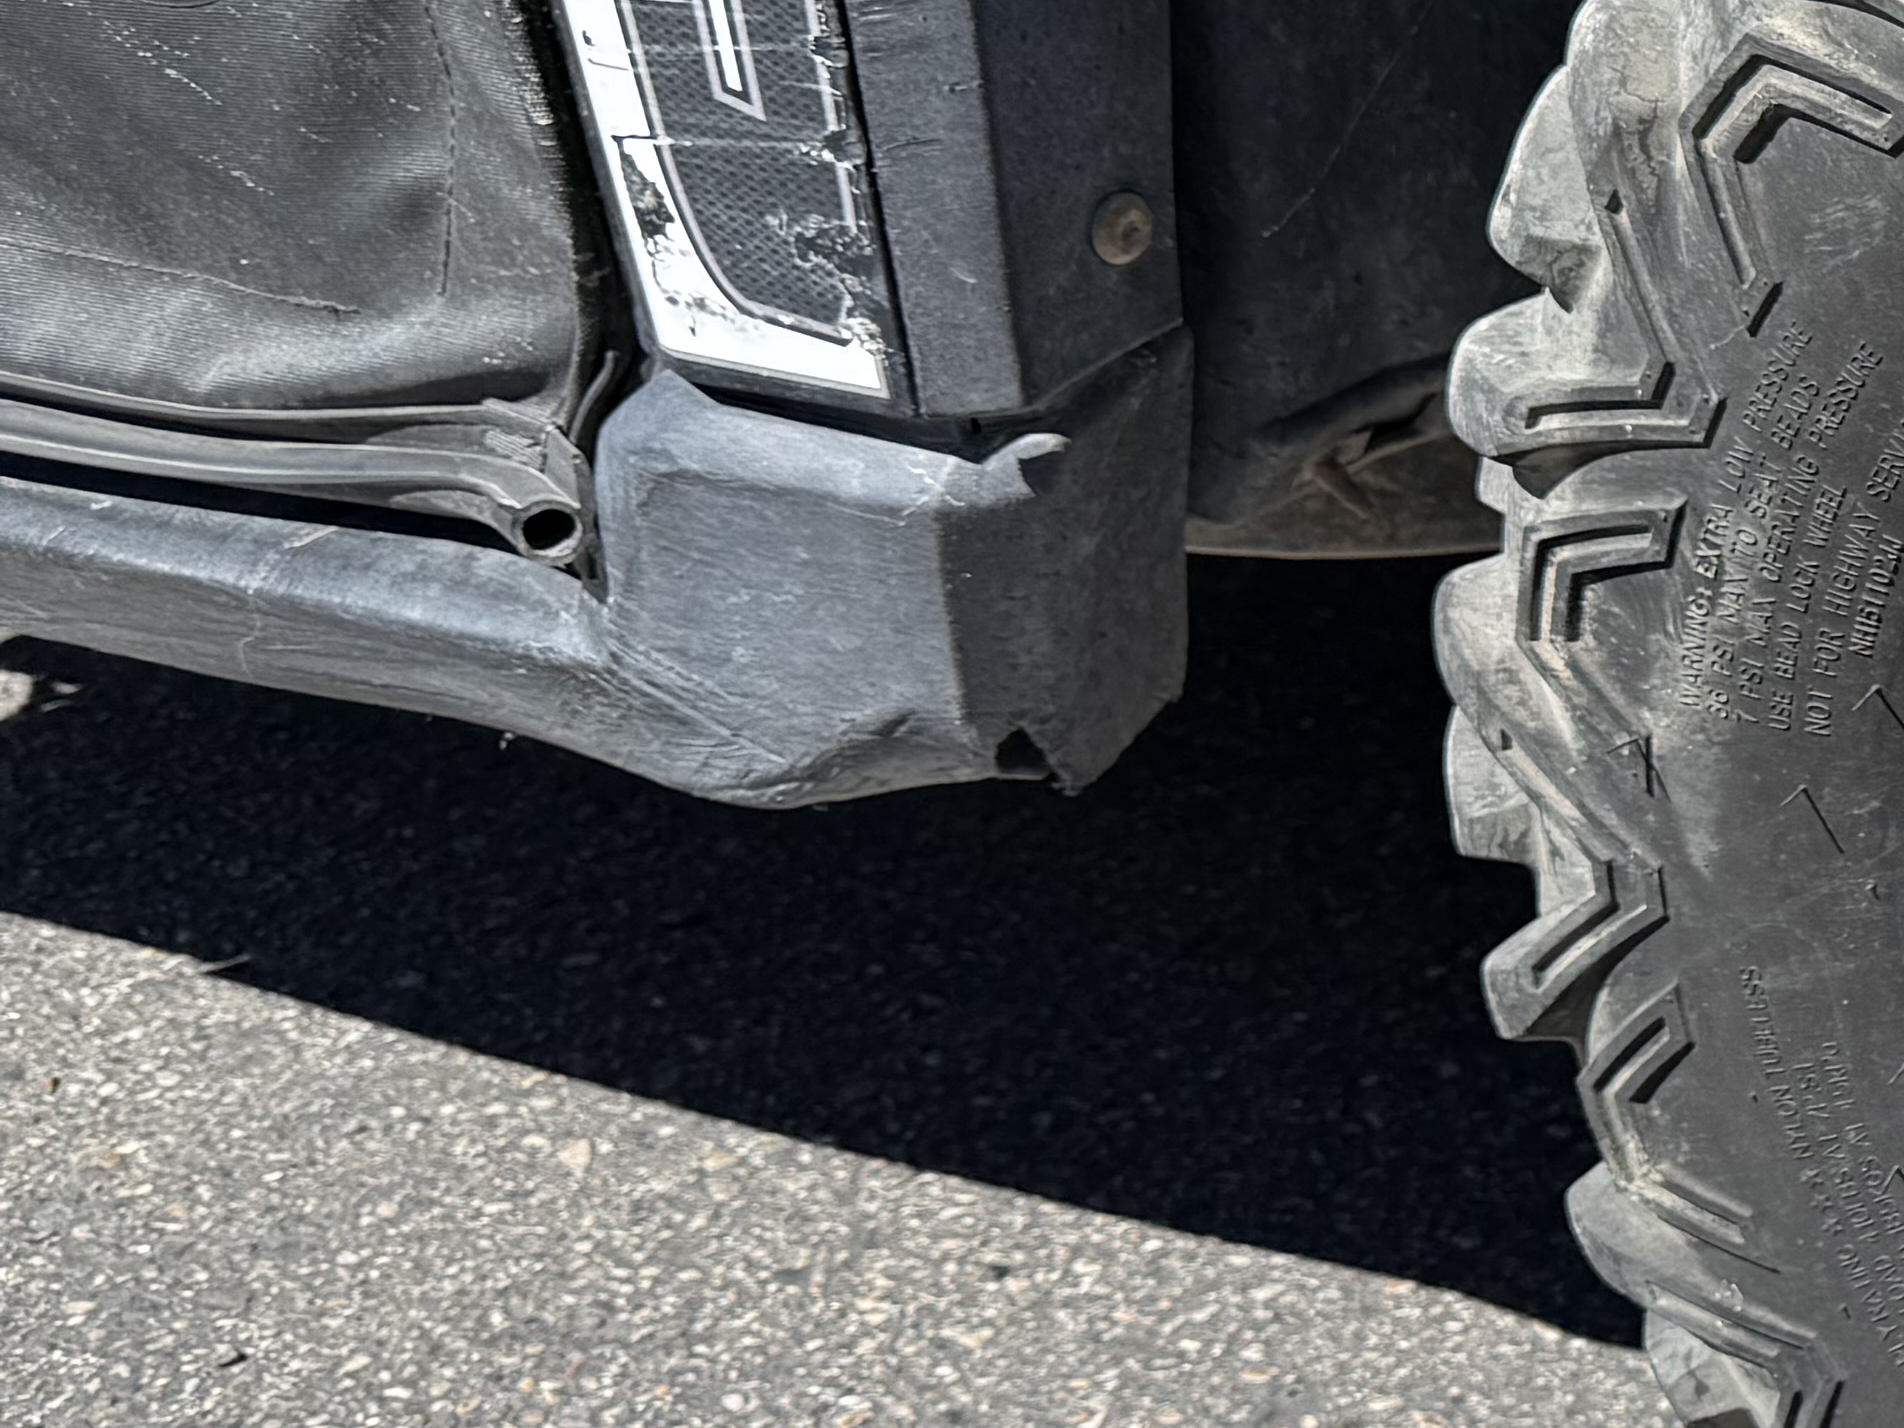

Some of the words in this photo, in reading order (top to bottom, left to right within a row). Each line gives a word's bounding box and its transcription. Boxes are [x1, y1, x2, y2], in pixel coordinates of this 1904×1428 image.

[1741, 317, 1814, 432] PRESSURE
[1808, 341, 1884, 447] PRESSURE
[1769, 373, 1821, 449] BEADS
[1720, 436, 1755, 493] LOW
[1745, 455, 1783, 519] SEAT
[1694, 502, 1733, 578] EXTRA
[1731, 526, 1757, 558] TO
[1763, 452, 1821, 583] OPERATING
[1805, 478, 1847, 550] WHEEL
[1786, 554, 1820, 613] LOCK
[1824, 503, 1881, 616] HIGHWAY
[1720, 569, 1749, 623] MAX
[1750, 595, 1776, 645] MAX
[1678, 585, 1714, 710] WARNING:
[1717, 632, 1737, 676] PSI
[1738, 655, 1763, 698] PSI
[1774, 618, 1803, 679] BEAD
[1813, 626, 1842, 676] FOR
[1709, 688, 1730, 720] 36
[1735, 708, 1758, 725] 7
[1768, 689, 1792, 730] USE
[1805, 684, 1833, 738] NOT
[1736, 964, 1784, 1080] TUBELESS
[1768, 1082, 1814, 1162] NYLON
